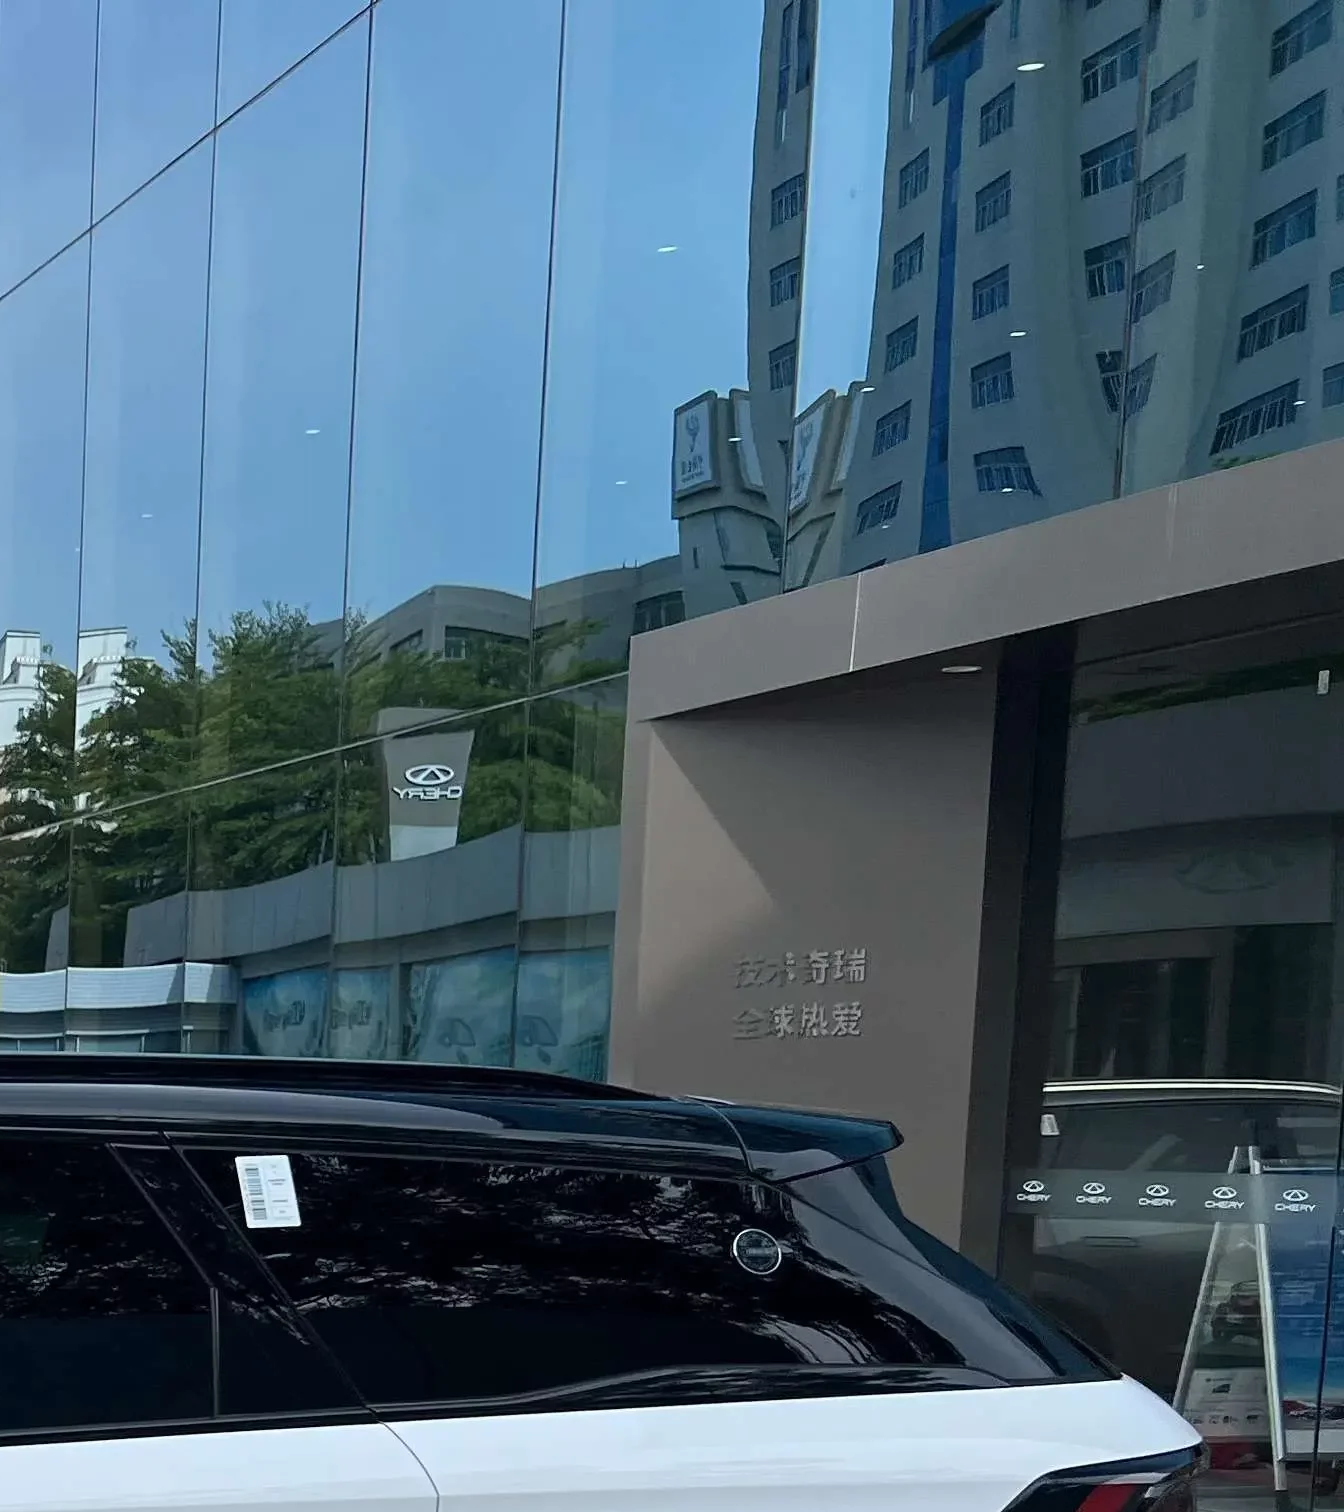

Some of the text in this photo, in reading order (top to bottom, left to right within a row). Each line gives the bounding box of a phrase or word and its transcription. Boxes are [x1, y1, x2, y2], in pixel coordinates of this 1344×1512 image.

[1016, 1193, 1052, 1202] CHERY
[1075, 1195, 1112, 1204] CHERY
[1138, 1197, 1177, 1206] CHERY
[1204, 1200, 1245, 1209] CHERY
[1274, 1203, 1316, 1212] CHERY
